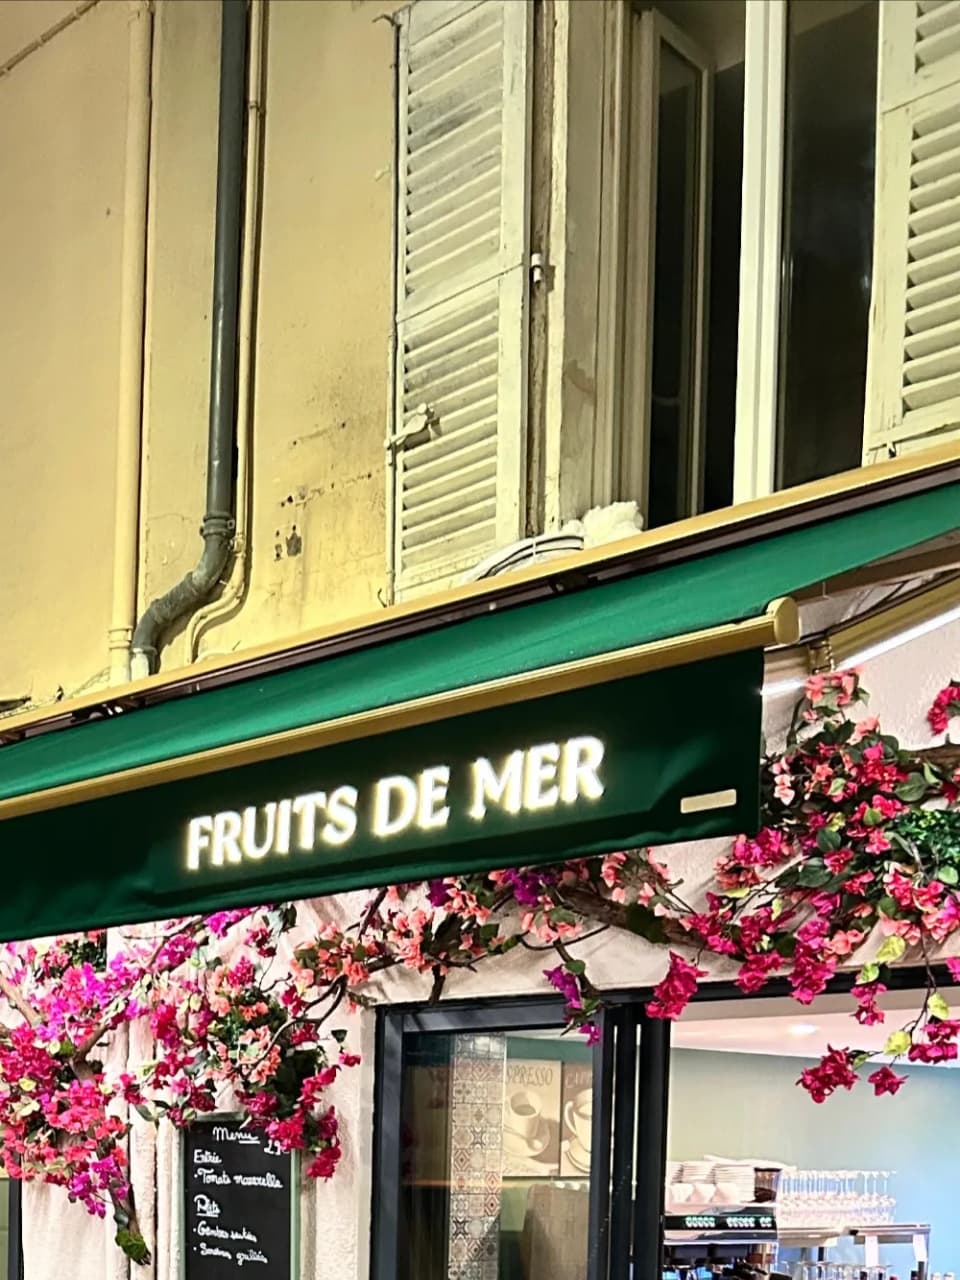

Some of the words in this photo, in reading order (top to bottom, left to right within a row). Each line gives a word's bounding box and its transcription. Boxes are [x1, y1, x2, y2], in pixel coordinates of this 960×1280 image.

[186, 785, 359, 870] FRUITS
[372, 765, 451, 837] DE
[468, 735, 606, 821] MER
[506, 1065, 553, 1087] SPRESSO
[213, 1126, 259, 1141] Menu
